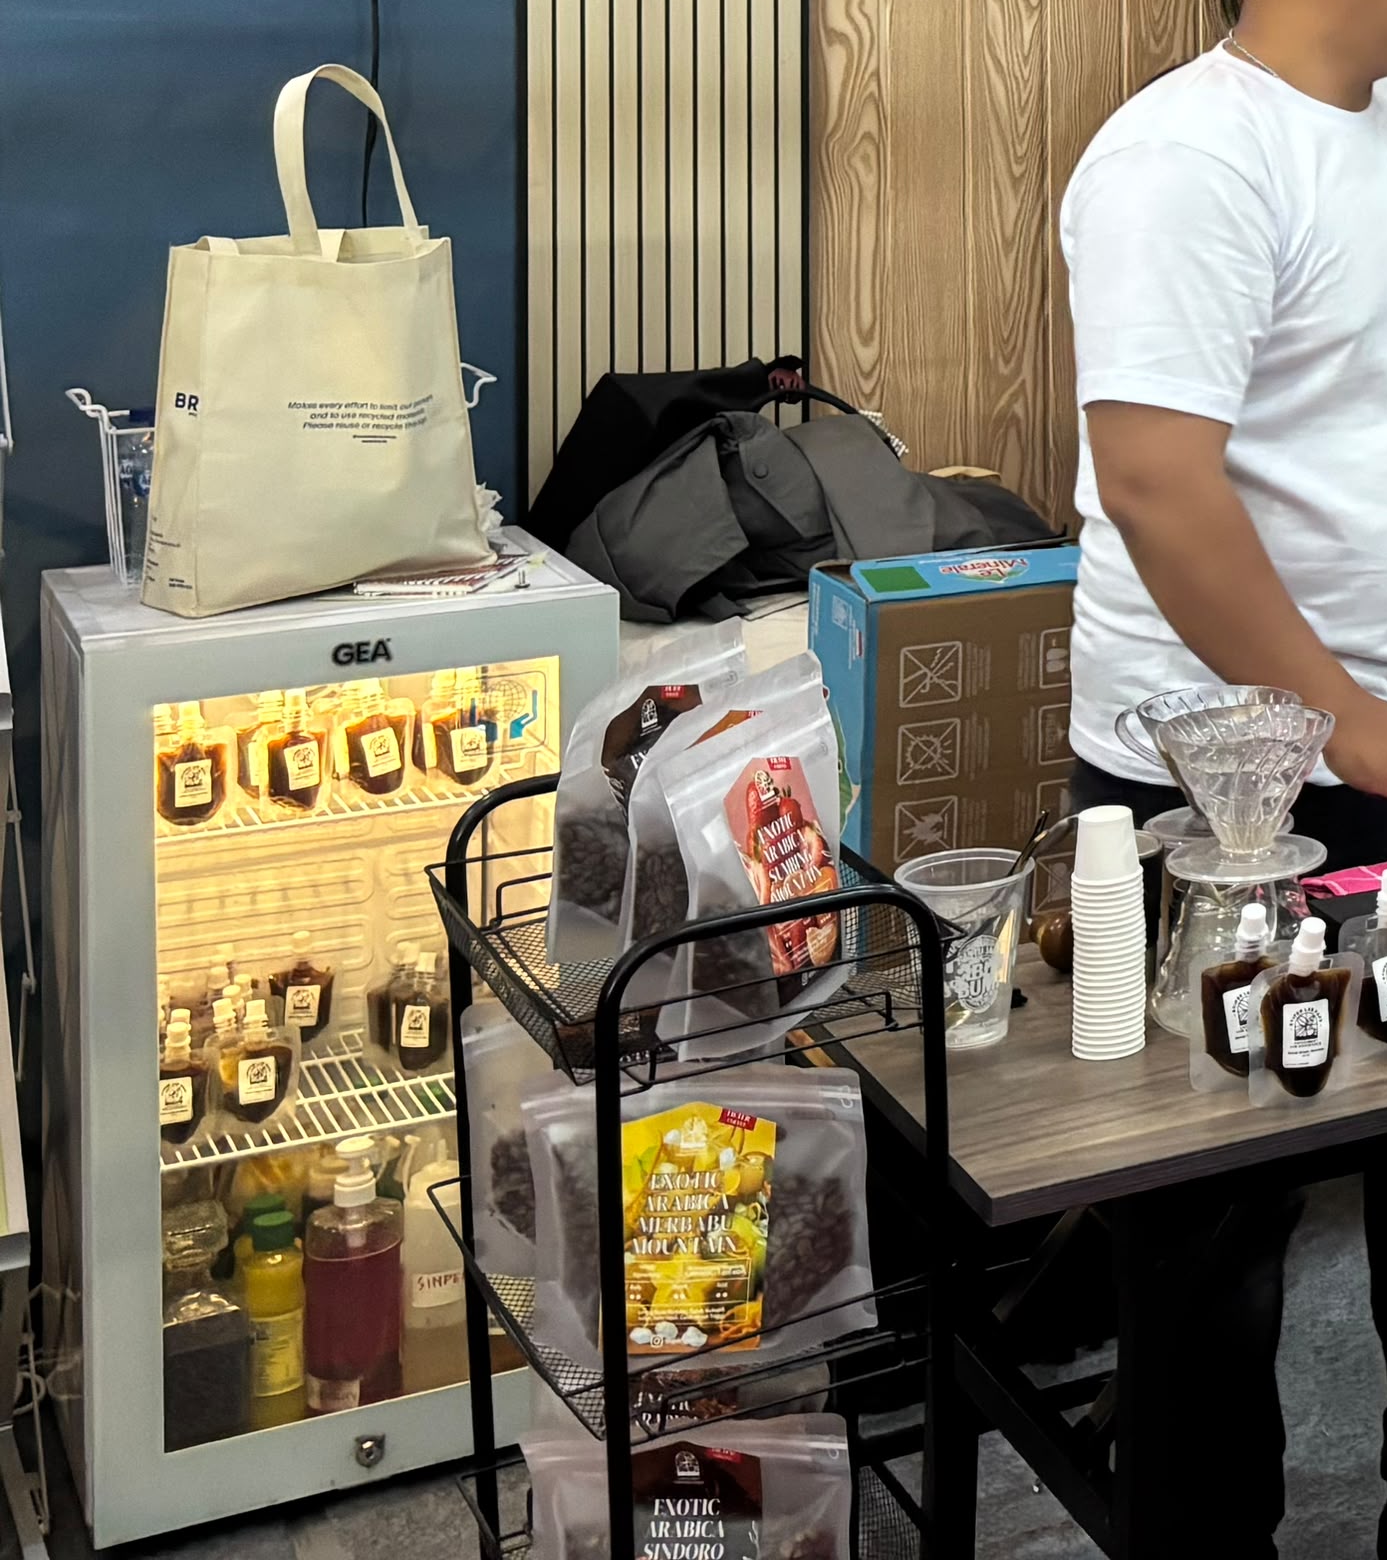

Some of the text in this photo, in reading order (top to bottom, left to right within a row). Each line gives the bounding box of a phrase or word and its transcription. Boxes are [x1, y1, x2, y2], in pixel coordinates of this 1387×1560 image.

[331, 638, 392, 667] GEA
[763, 829, 806, 864] ARABICA
[768, 851, 812, 883] SUMBING
[650, 1171, 723, 1190] EXOTIC
[646, 1194, 729, 1212] ARABICA
[653, 1499, 720, 1517] EXOTIC
[650, 1520, 724, 1538] ARABICA
[644, 1543, 724, 1560] SINDORO
